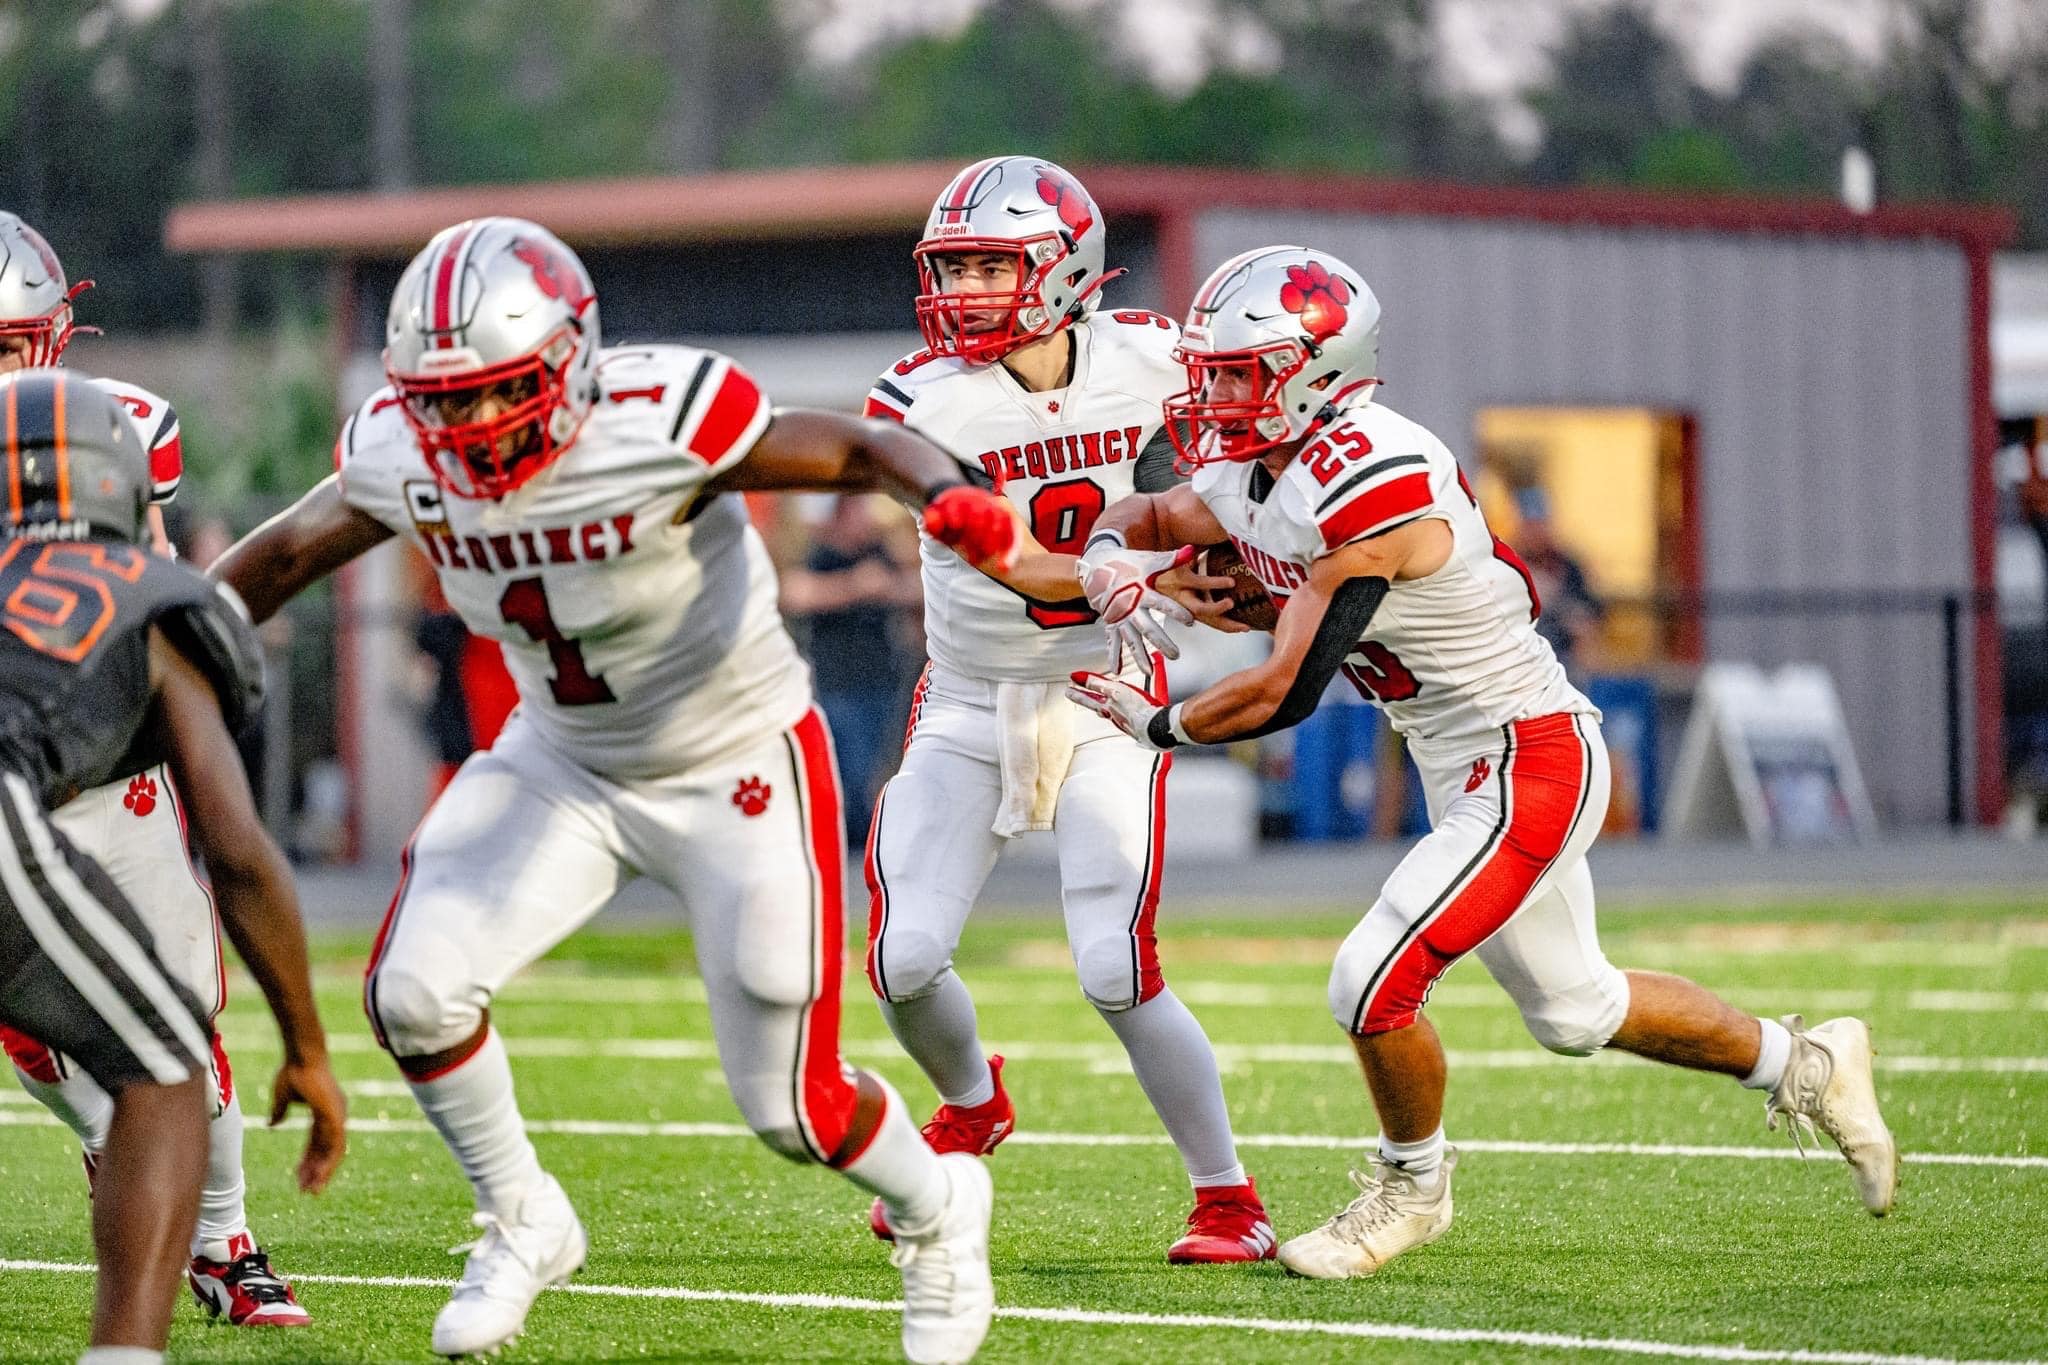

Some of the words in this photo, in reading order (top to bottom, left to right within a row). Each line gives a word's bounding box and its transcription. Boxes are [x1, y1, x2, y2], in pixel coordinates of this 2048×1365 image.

[933, 225, 967, 236] Rddell
[1111, 311, 1172, 330] 9
[609, 385, 667, 404] 1
[979, 425, 1142, 482] DEQUINCY
[1300, 422, 1373, 488] 25
[404, 480, 447, 524] C
[499, 576, 618, 706] 1
